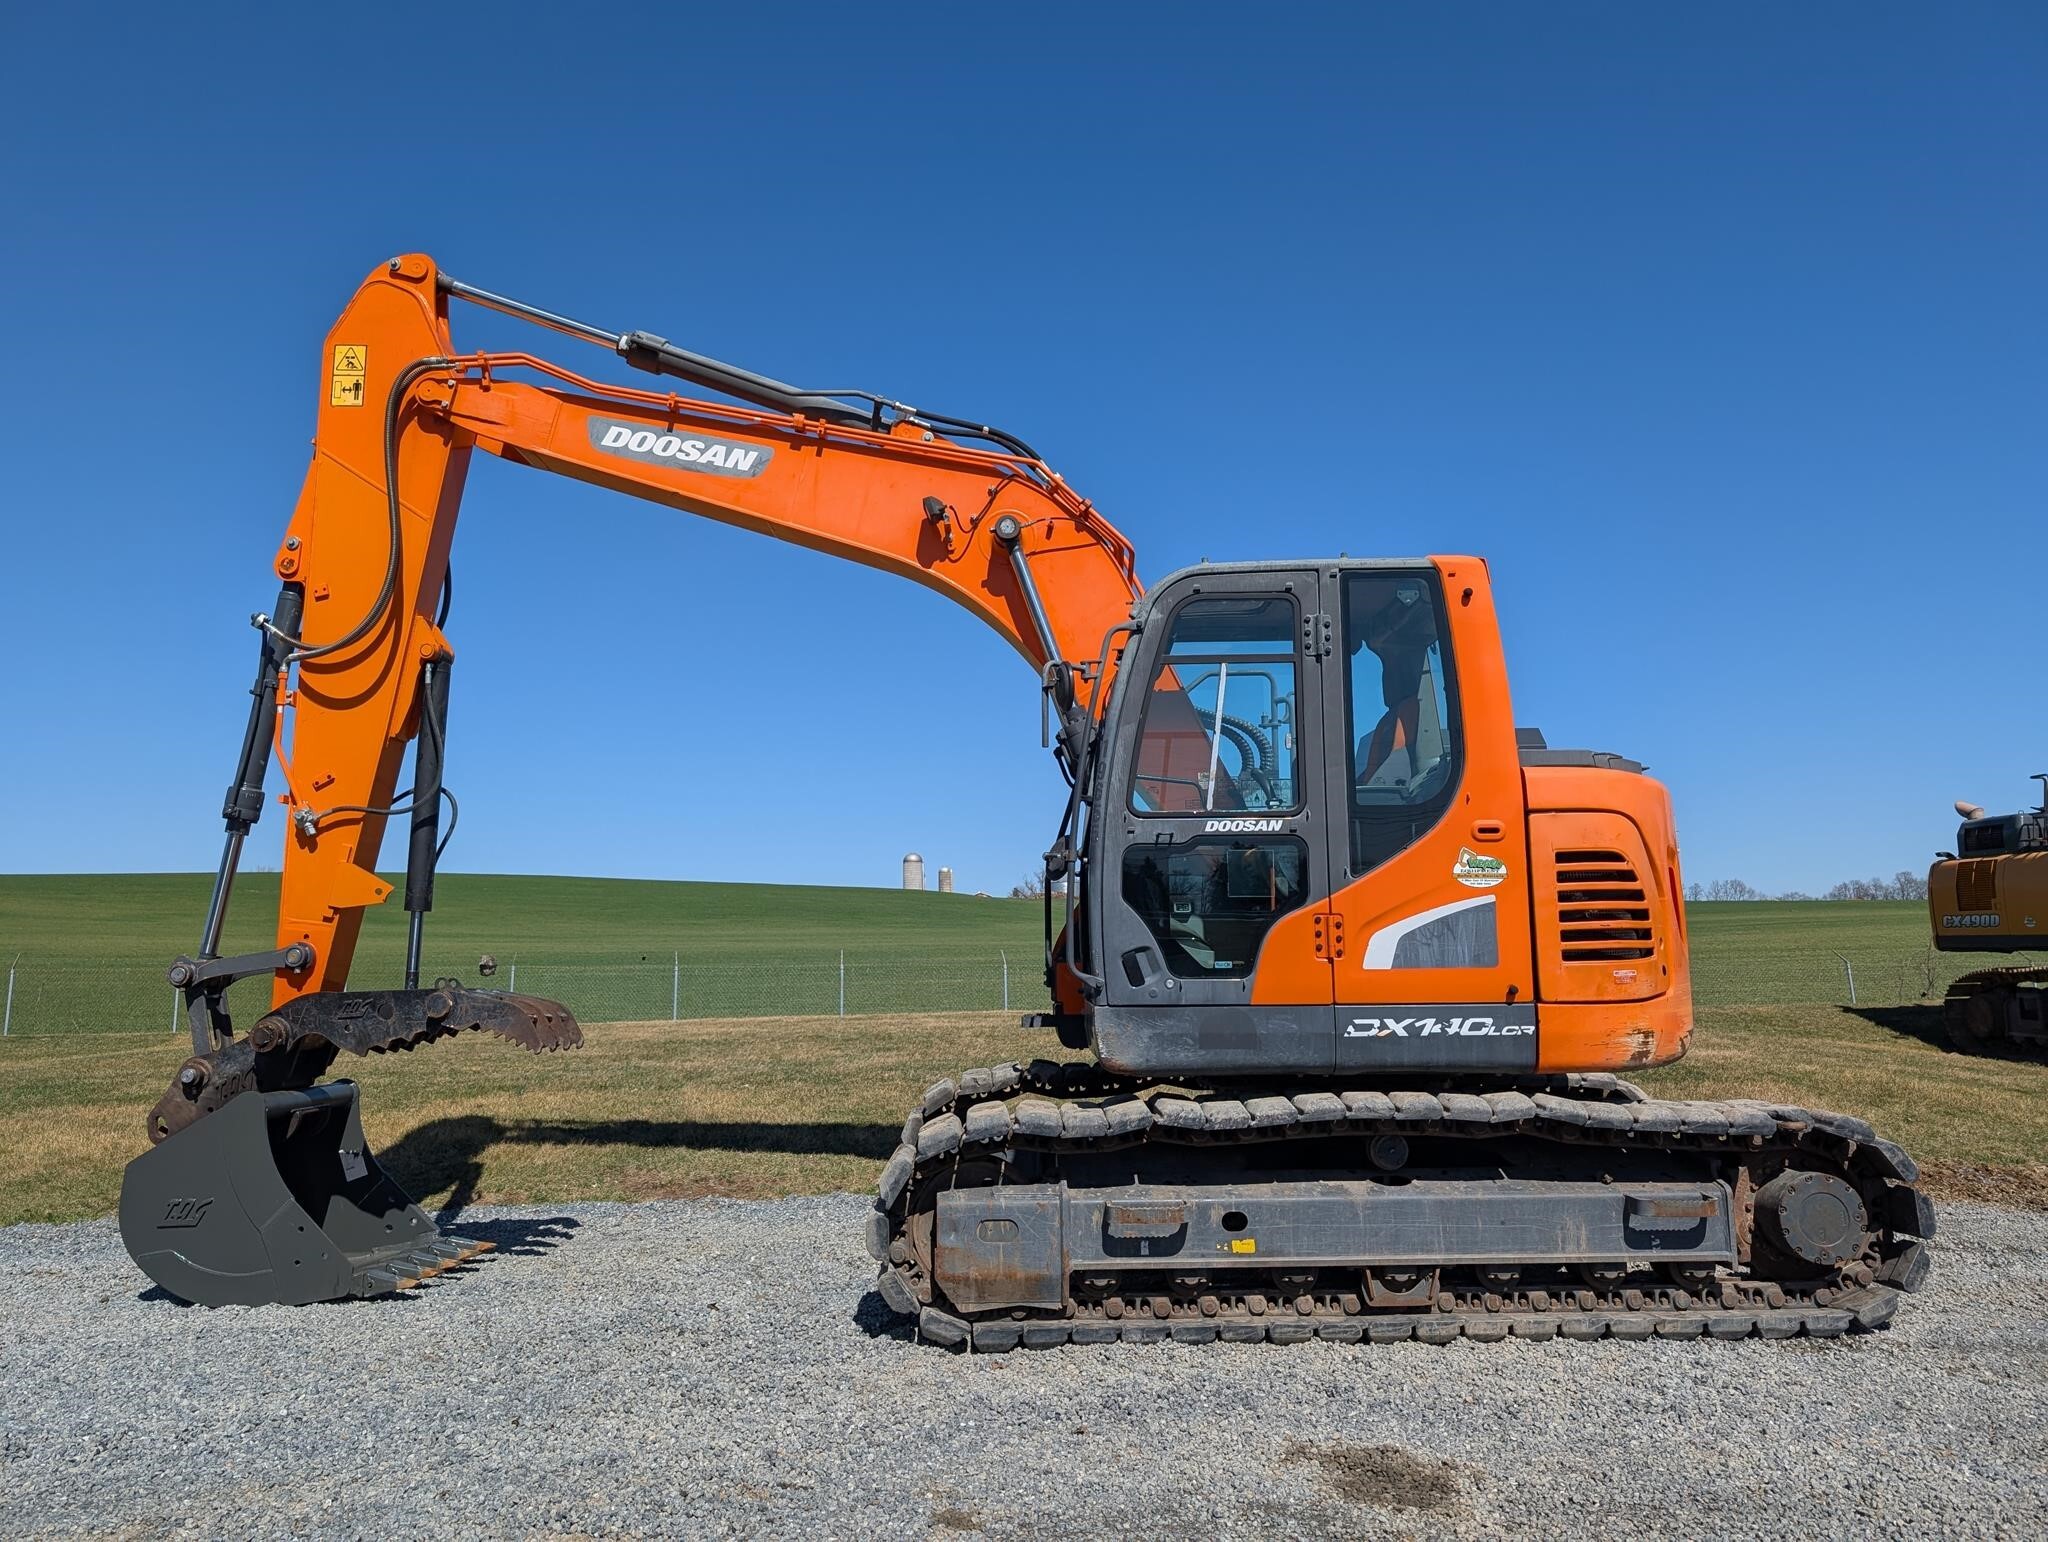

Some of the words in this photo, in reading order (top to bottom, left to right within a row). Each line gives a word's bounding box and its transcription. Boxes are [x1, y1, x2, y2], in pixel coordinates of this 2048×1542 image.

[601, 425, 758, 471] DOOSAN
[1204, 819, 1283, 832] DOOSAN
[1943, 914, 2001, 928] CX490D
